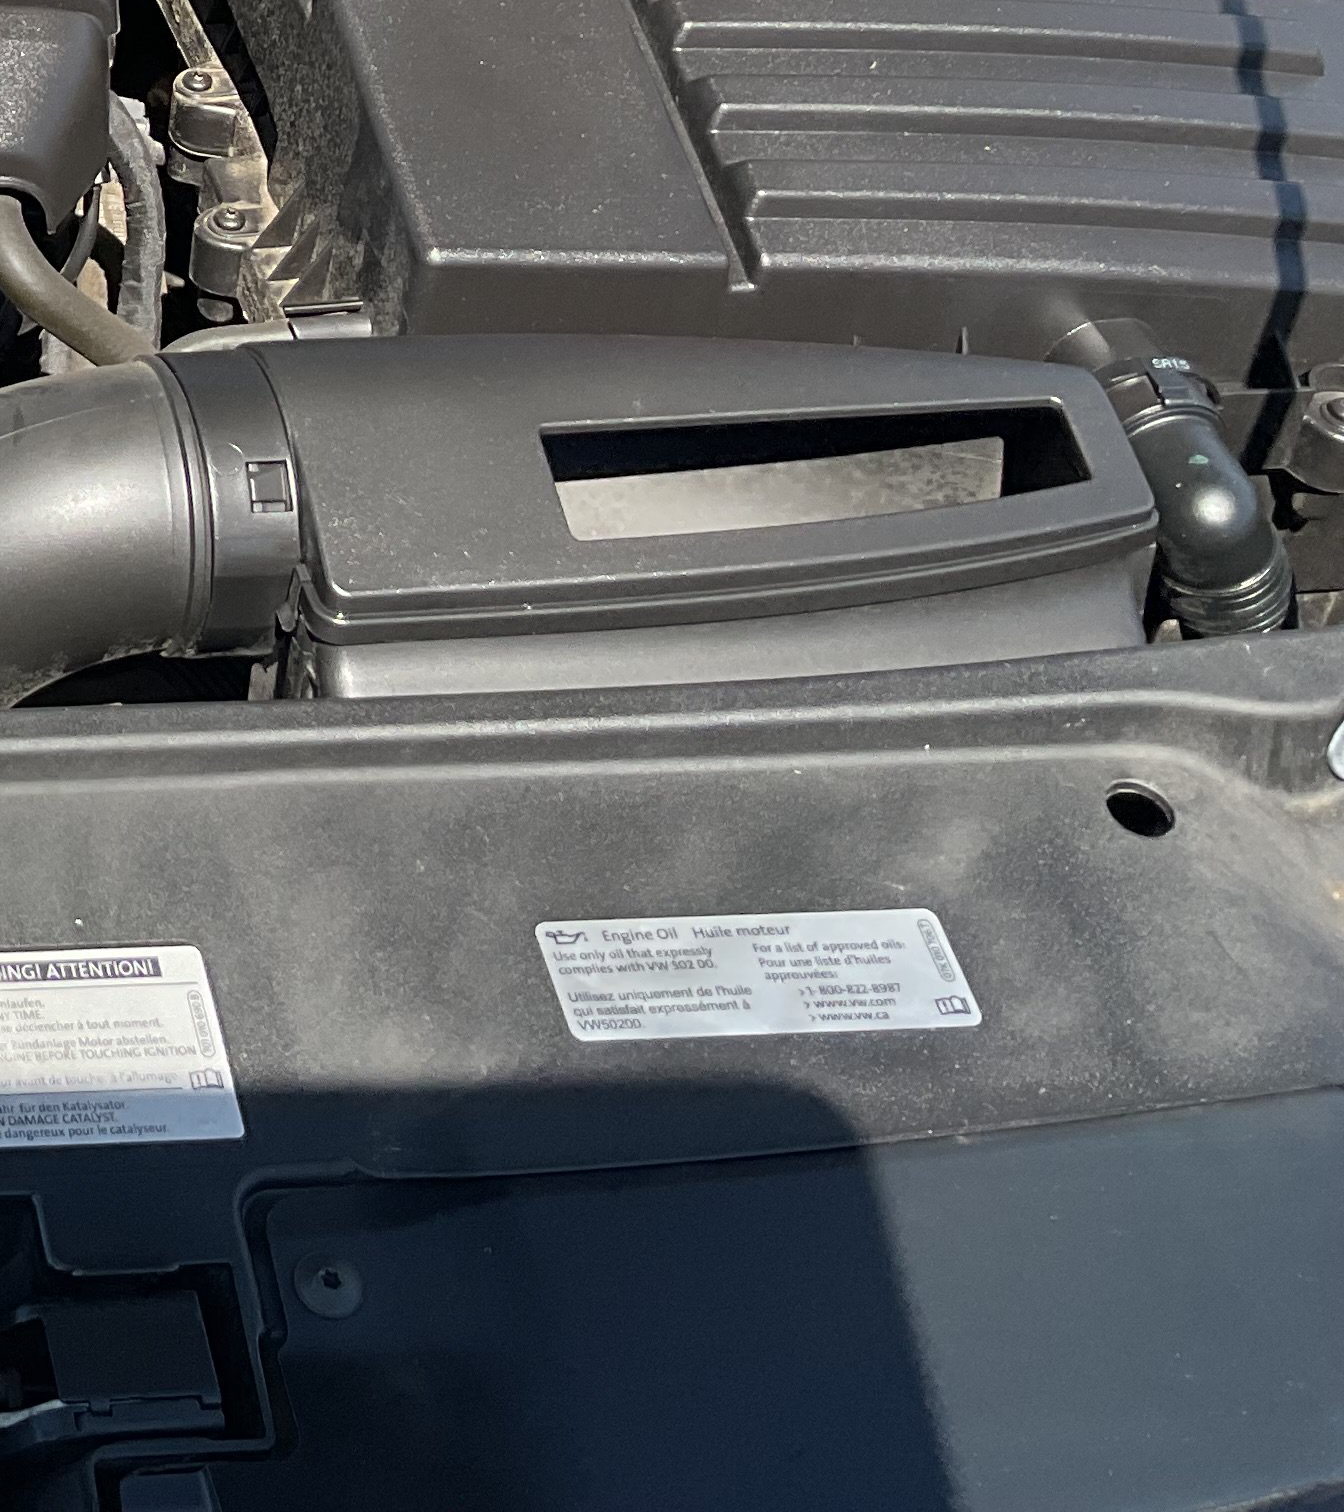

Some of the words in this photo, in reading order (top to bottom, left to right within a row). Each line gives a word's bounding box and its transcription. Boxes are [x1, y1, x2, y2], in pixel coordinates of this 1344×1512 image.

[602, 930, 653, 944] Engine
[657, 927, 678, 941] Oil
[692, 927, 732, 939] Huile
[736, 925, 790, 938] moteur
[553, 951, 577, 961] Use
[580, 949, 605, 963] only
[609, 947, 624, 959] oil
[627, 947, 653, 958] that
[656, 945, 712, 958] expressly
[752, 943, 772, 953] For
[786, 942, 803, 953] list
[807, 941, 818, 952] of
[822, 940, 879, 954] approved
[558, 962, 613, 976] complies
[616, 960, 645, 972] with
[647, 960, 669, 971] VW
[758, 957, 786, 968] Pour
[789, 957, 812, 967] une
[815, 955, 841, 966] liste
[46, 959, 154, 980] ATTENTION!
[567, 991, 614, 1003] Utilisez
[618, 987, 694, 1002] uniquement
[696, 986, 712, 997] de
[573, 1006, 594, 1017] qui
[596, 1004, 646, 1015] satisfait
[648, 999, 739, 1015] expressément
[86, 1018, 111, 1030] tout
[78, 1036, 112, 1048] Motor
[144, 1044, 197, 1058] IGNITION
[20, 1102, 37, 1113] für
[39, 1102, 60, 1113] den
[8, 1113, 60, 1126] DAMAGE
[5, 1127, 65, 1141] dangereux
[68, 1125, 94, 1139] pour
[97, 1124, 107, 1135] le
